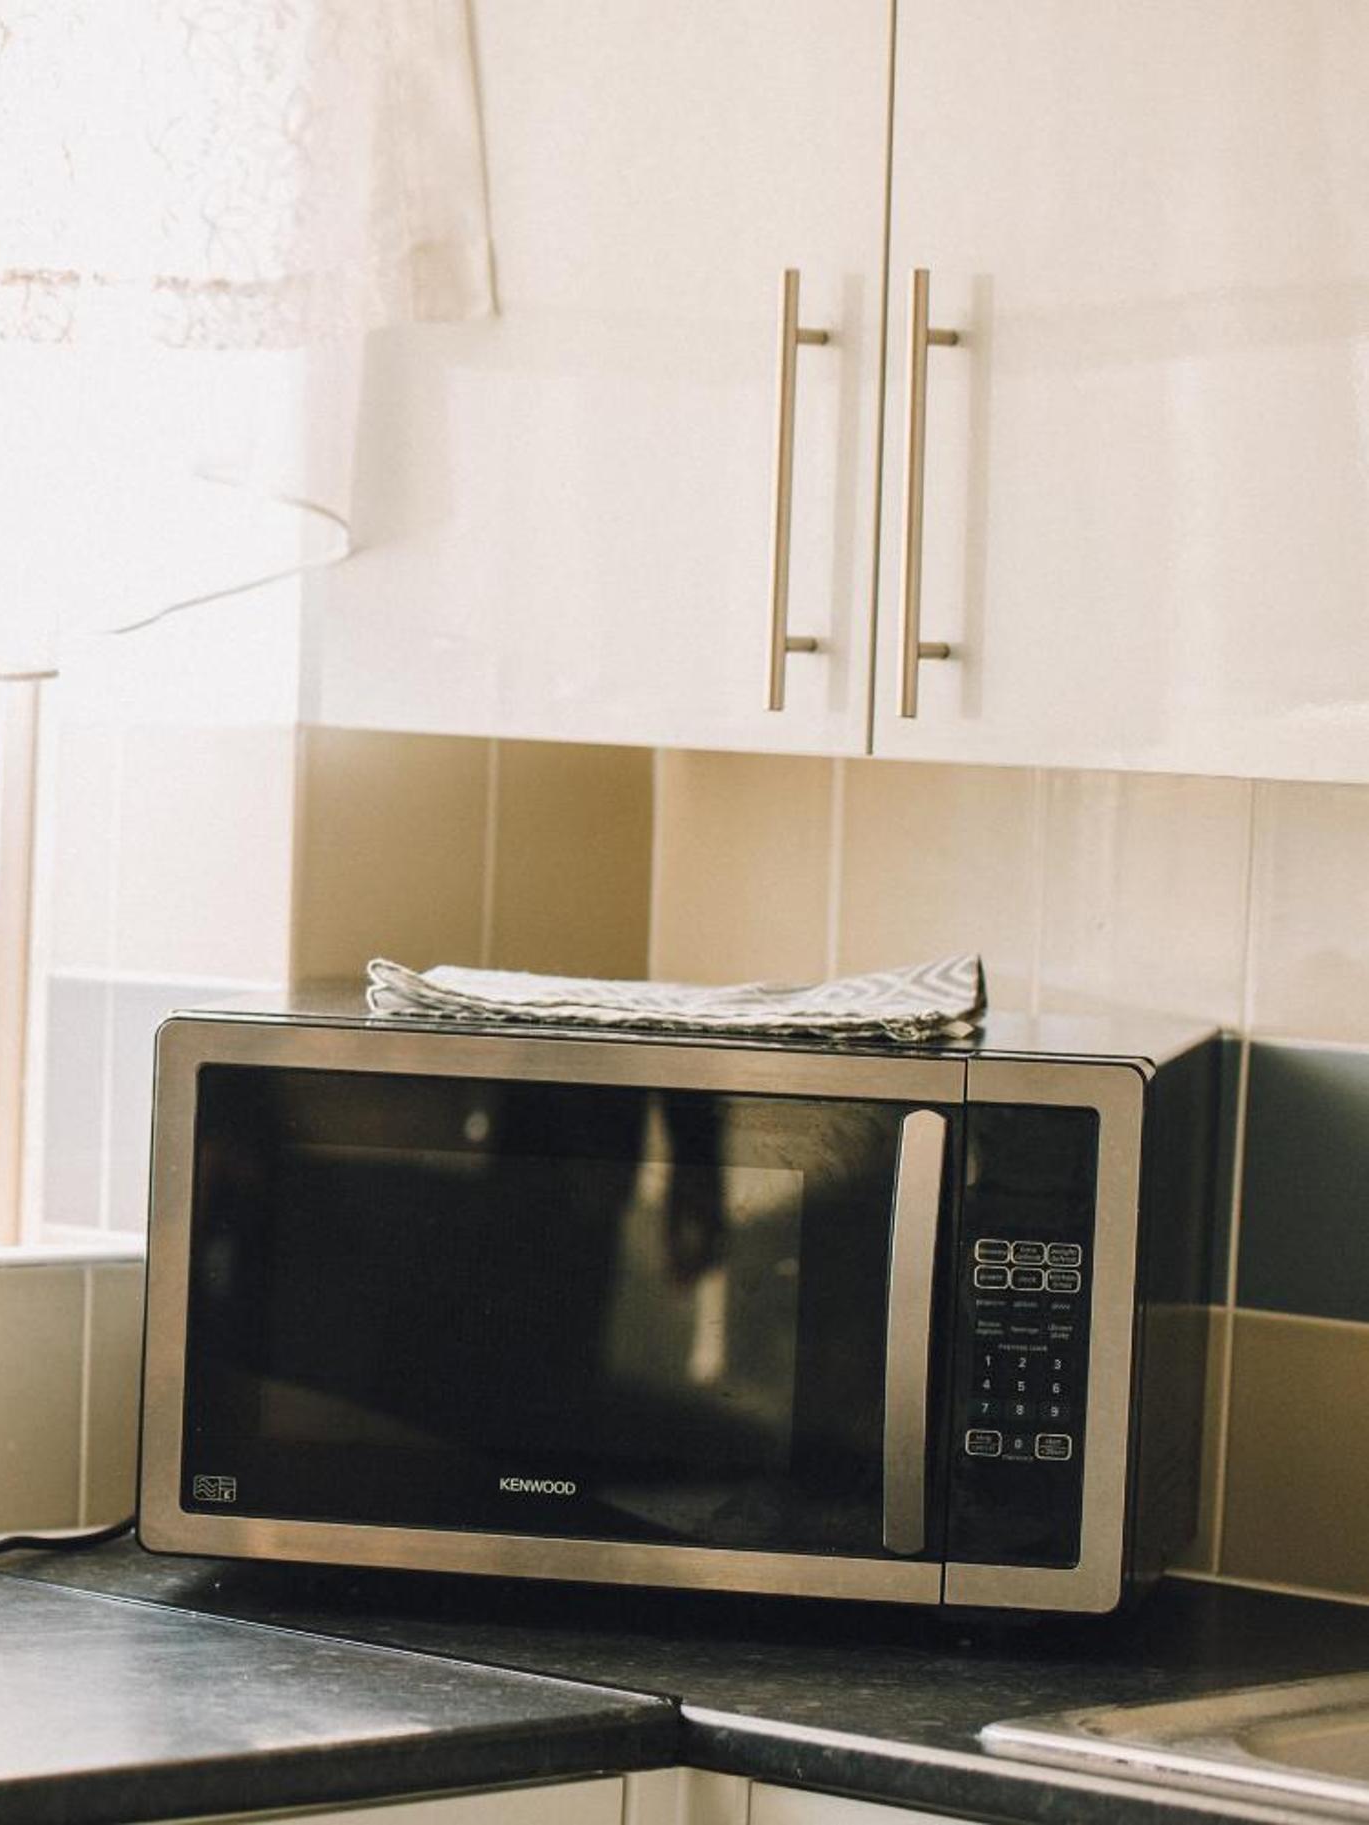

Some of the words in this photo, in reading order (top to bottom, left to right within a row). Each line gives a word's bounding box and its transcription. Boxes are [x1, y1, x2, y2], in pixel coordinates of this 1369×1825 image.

[985, 1355, 991, 1367] 1
[1017, 1357, 1027, 1368] 2
[1054, 1359, 1062, 1370] 3
[982, 1379, 991, 1389] 4
[1017, 1381, 1025, 1392] 5
[1052, 1383, 1060, 1393] 6
[981, 1402, 989, 1413] 7
[1015, 1405, 1024, 1415] 8
[1051, 1406, 1059, 1417] 9
[1014, 1439, 1022, 1449] 0
[499, 1477, 576, 1496] KENWOOD
